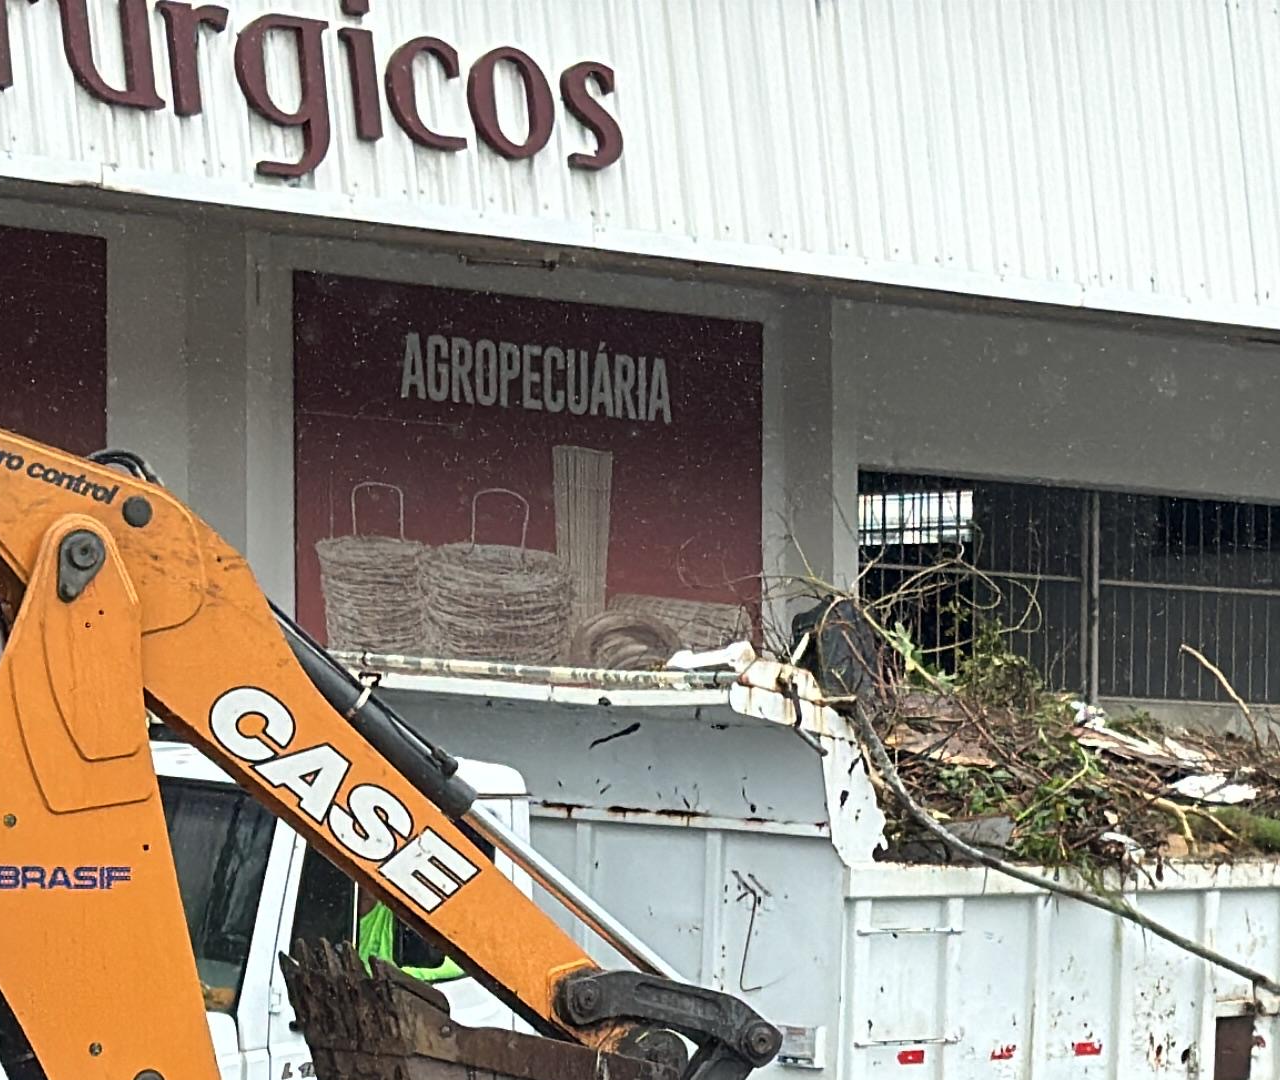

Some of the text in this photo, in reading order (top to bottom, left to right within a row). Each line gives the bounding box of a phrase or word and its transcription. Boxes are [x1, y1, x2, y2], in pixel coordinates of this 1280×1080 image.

[400, 331, 672, 424] AGROPECUÁRIA
[26, 462, 120, 505] control
[208, 685, 482, 914] CASE
